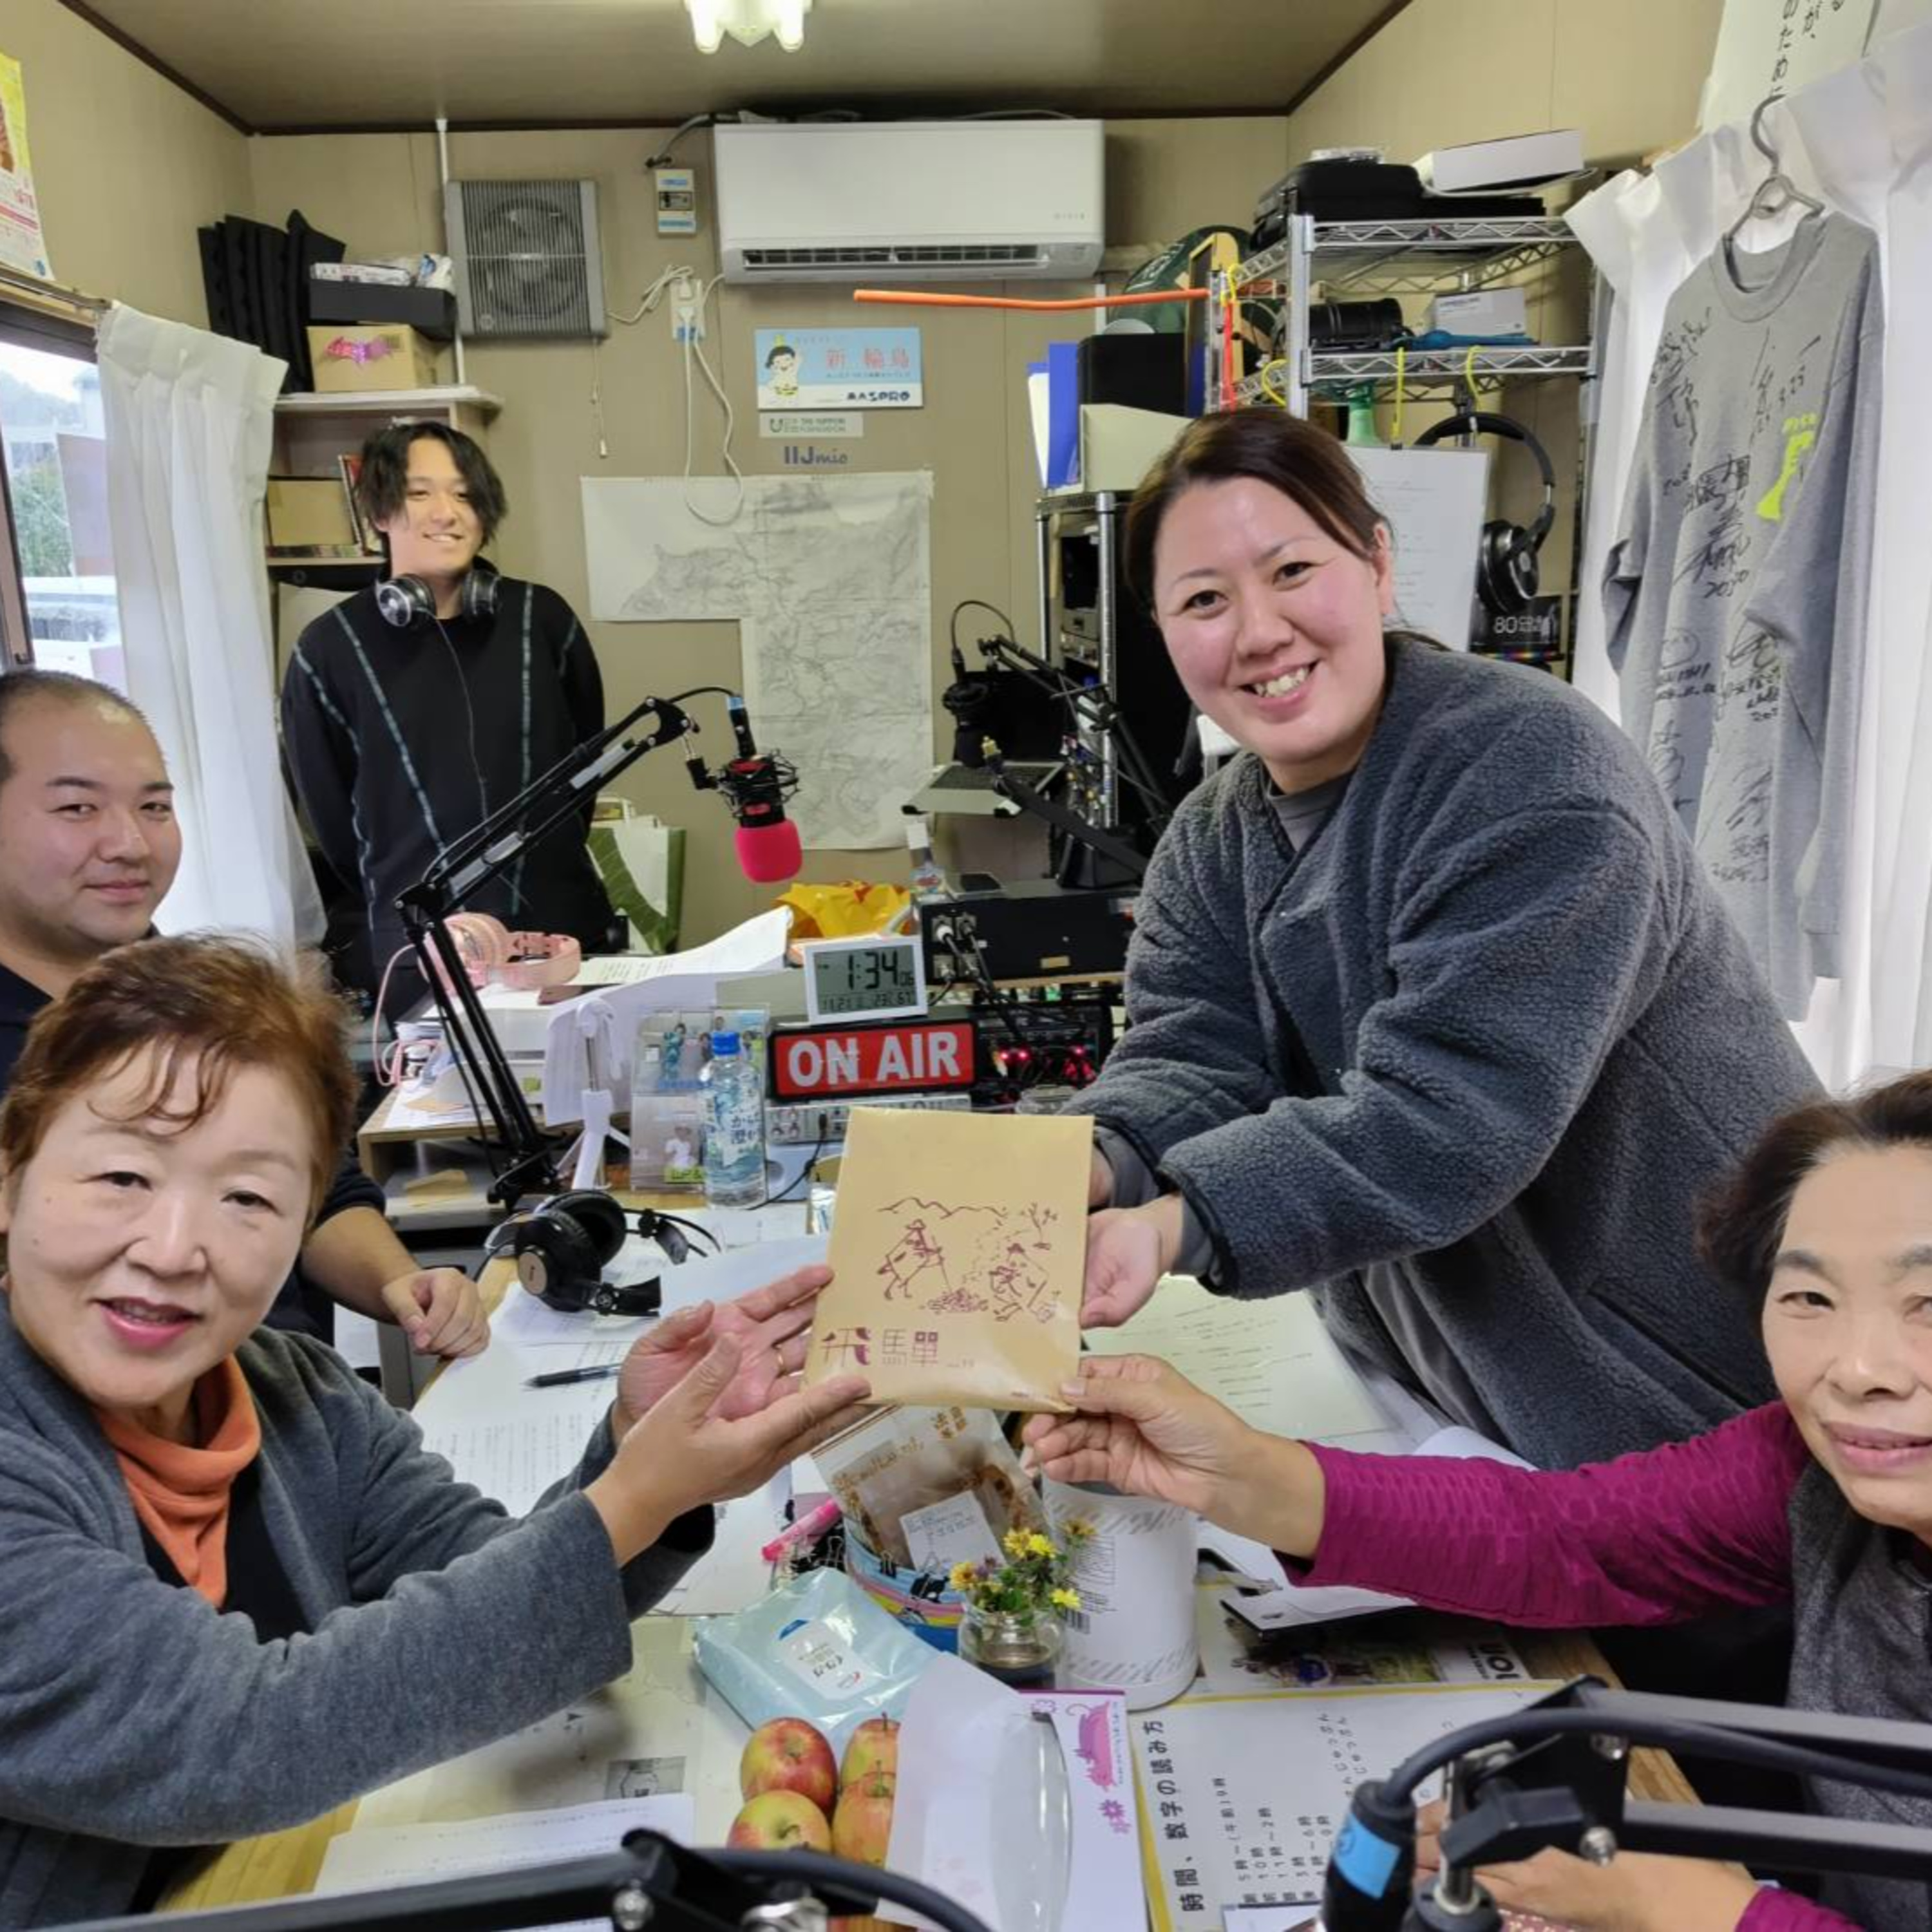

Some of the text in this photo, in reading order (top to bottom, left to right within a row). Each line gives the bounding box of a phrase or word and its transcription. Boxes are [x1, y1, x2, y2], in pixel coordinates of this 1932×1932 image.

[848, 950, 898, 990] 1:34
[788, 1032, 960, 1087] ON AIR
[1144, 1720, 1206, 1912] 時間、数字の読み方
